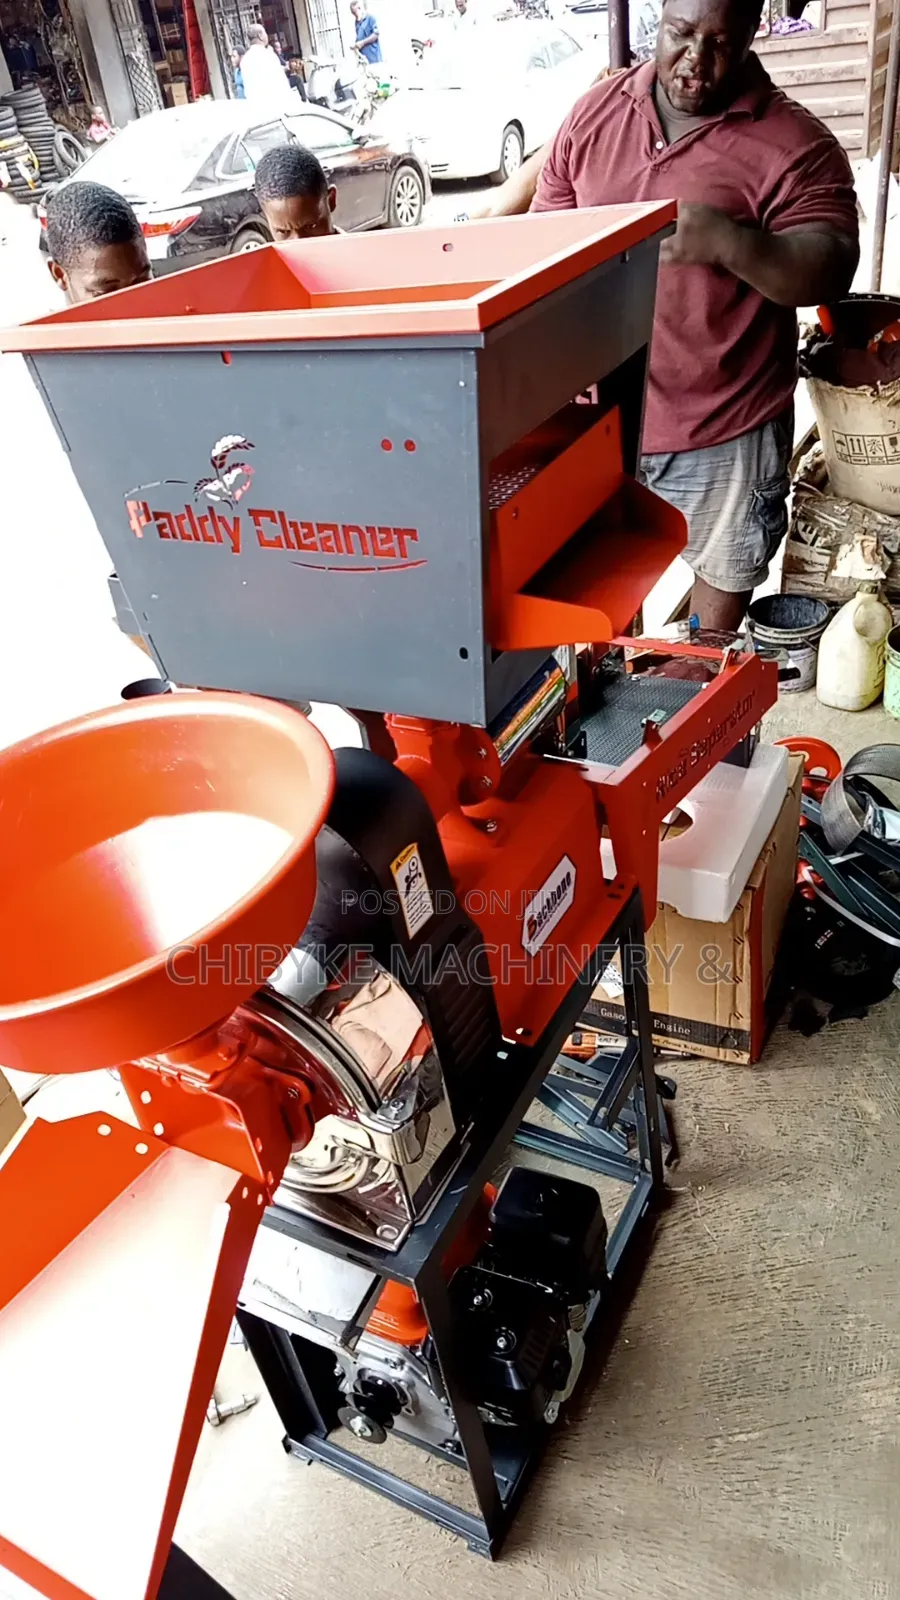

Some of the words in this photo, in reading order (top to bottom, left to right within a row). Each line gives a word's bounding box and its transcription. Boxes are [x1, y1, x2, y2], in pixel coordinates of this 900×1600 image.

[125, 499, 241, 555] Paddy
[247, 508, 420, 560] Cleaner
[653, 1019, 692, 1035] Engine
